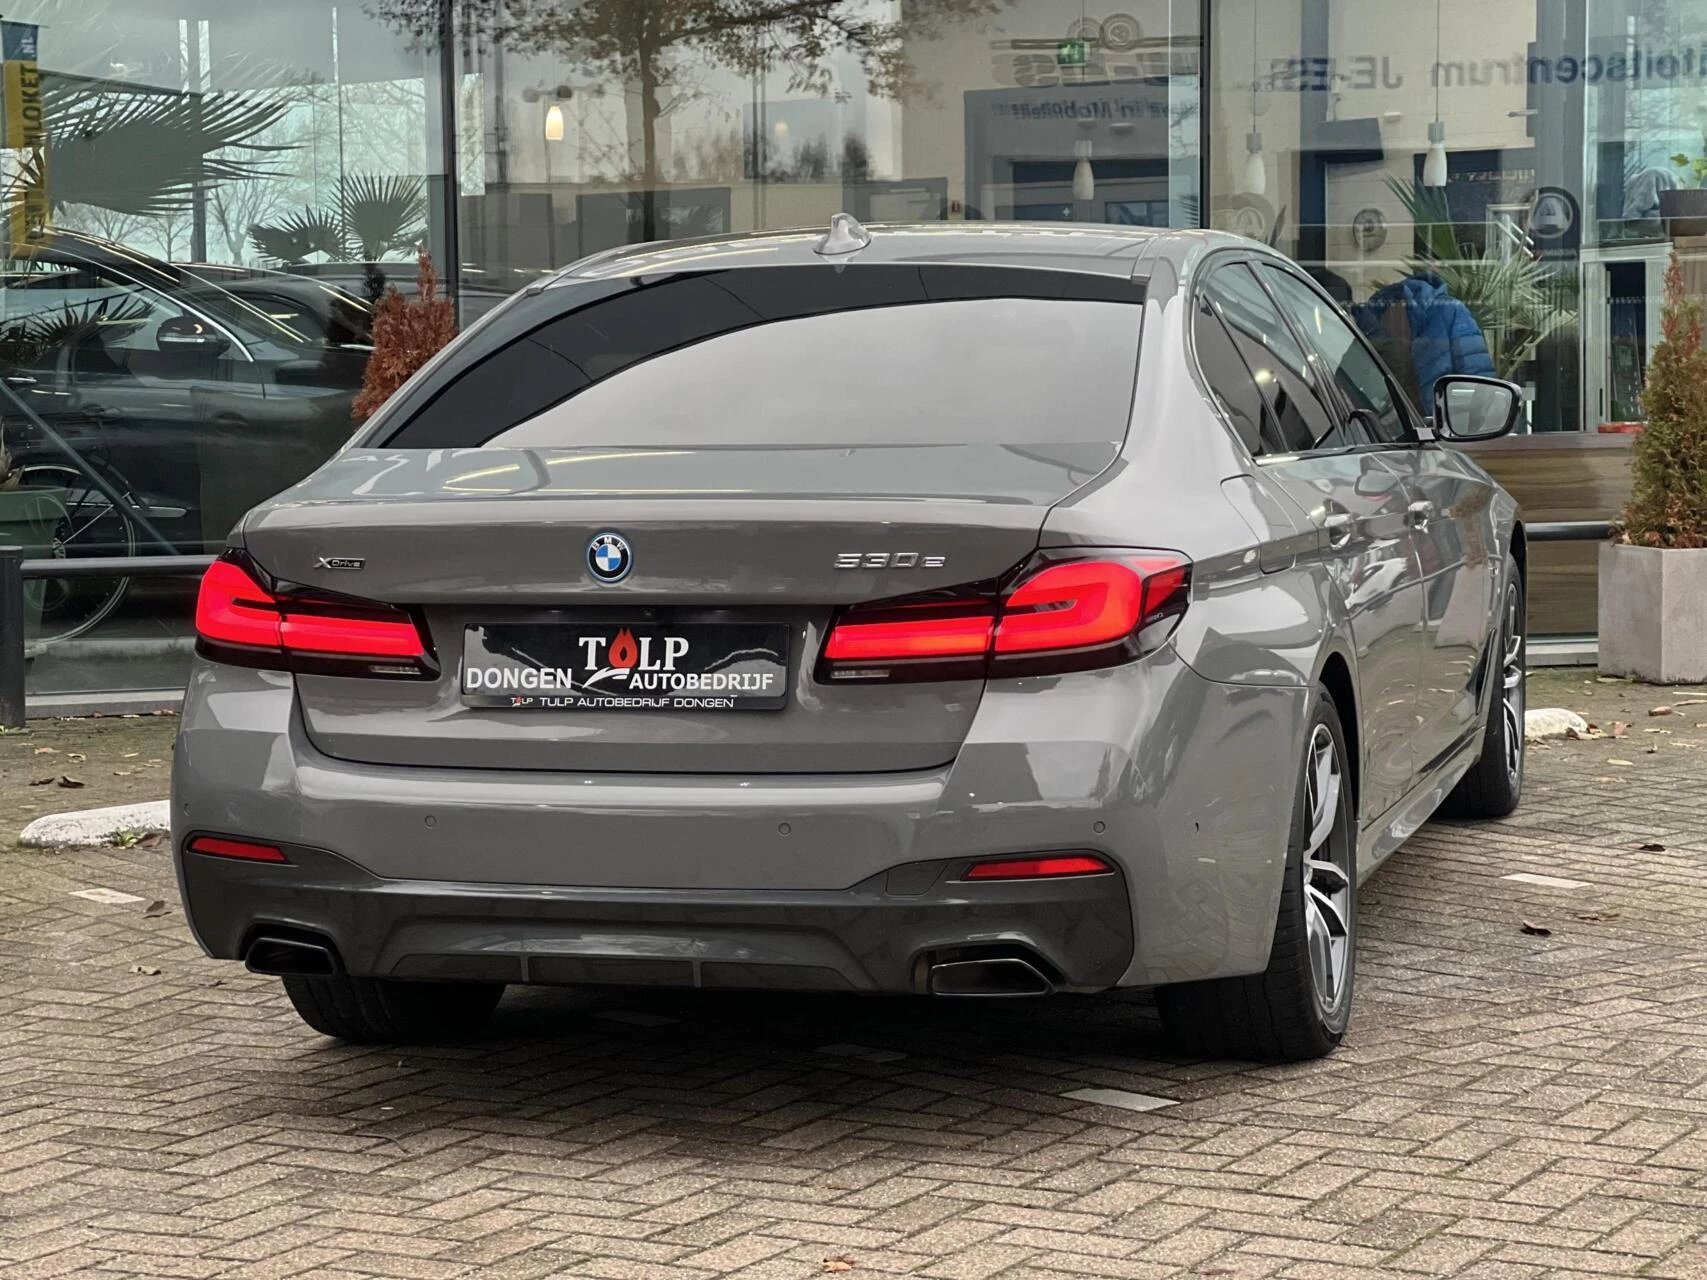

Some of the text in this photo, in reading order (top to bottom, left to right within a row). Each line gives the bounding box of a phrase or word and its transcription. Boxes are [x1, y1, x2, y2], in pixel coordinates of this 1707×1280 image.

[591, 536, 626, 550] BMW
[466, 667, 773, 691] DONGEN AUTOBEDRIJF
[540, 697, 574, 707] TULP
[577, 697, 670, 708] AUTOBEDRIJF
[674, 697, 734, 708] DONGEN
